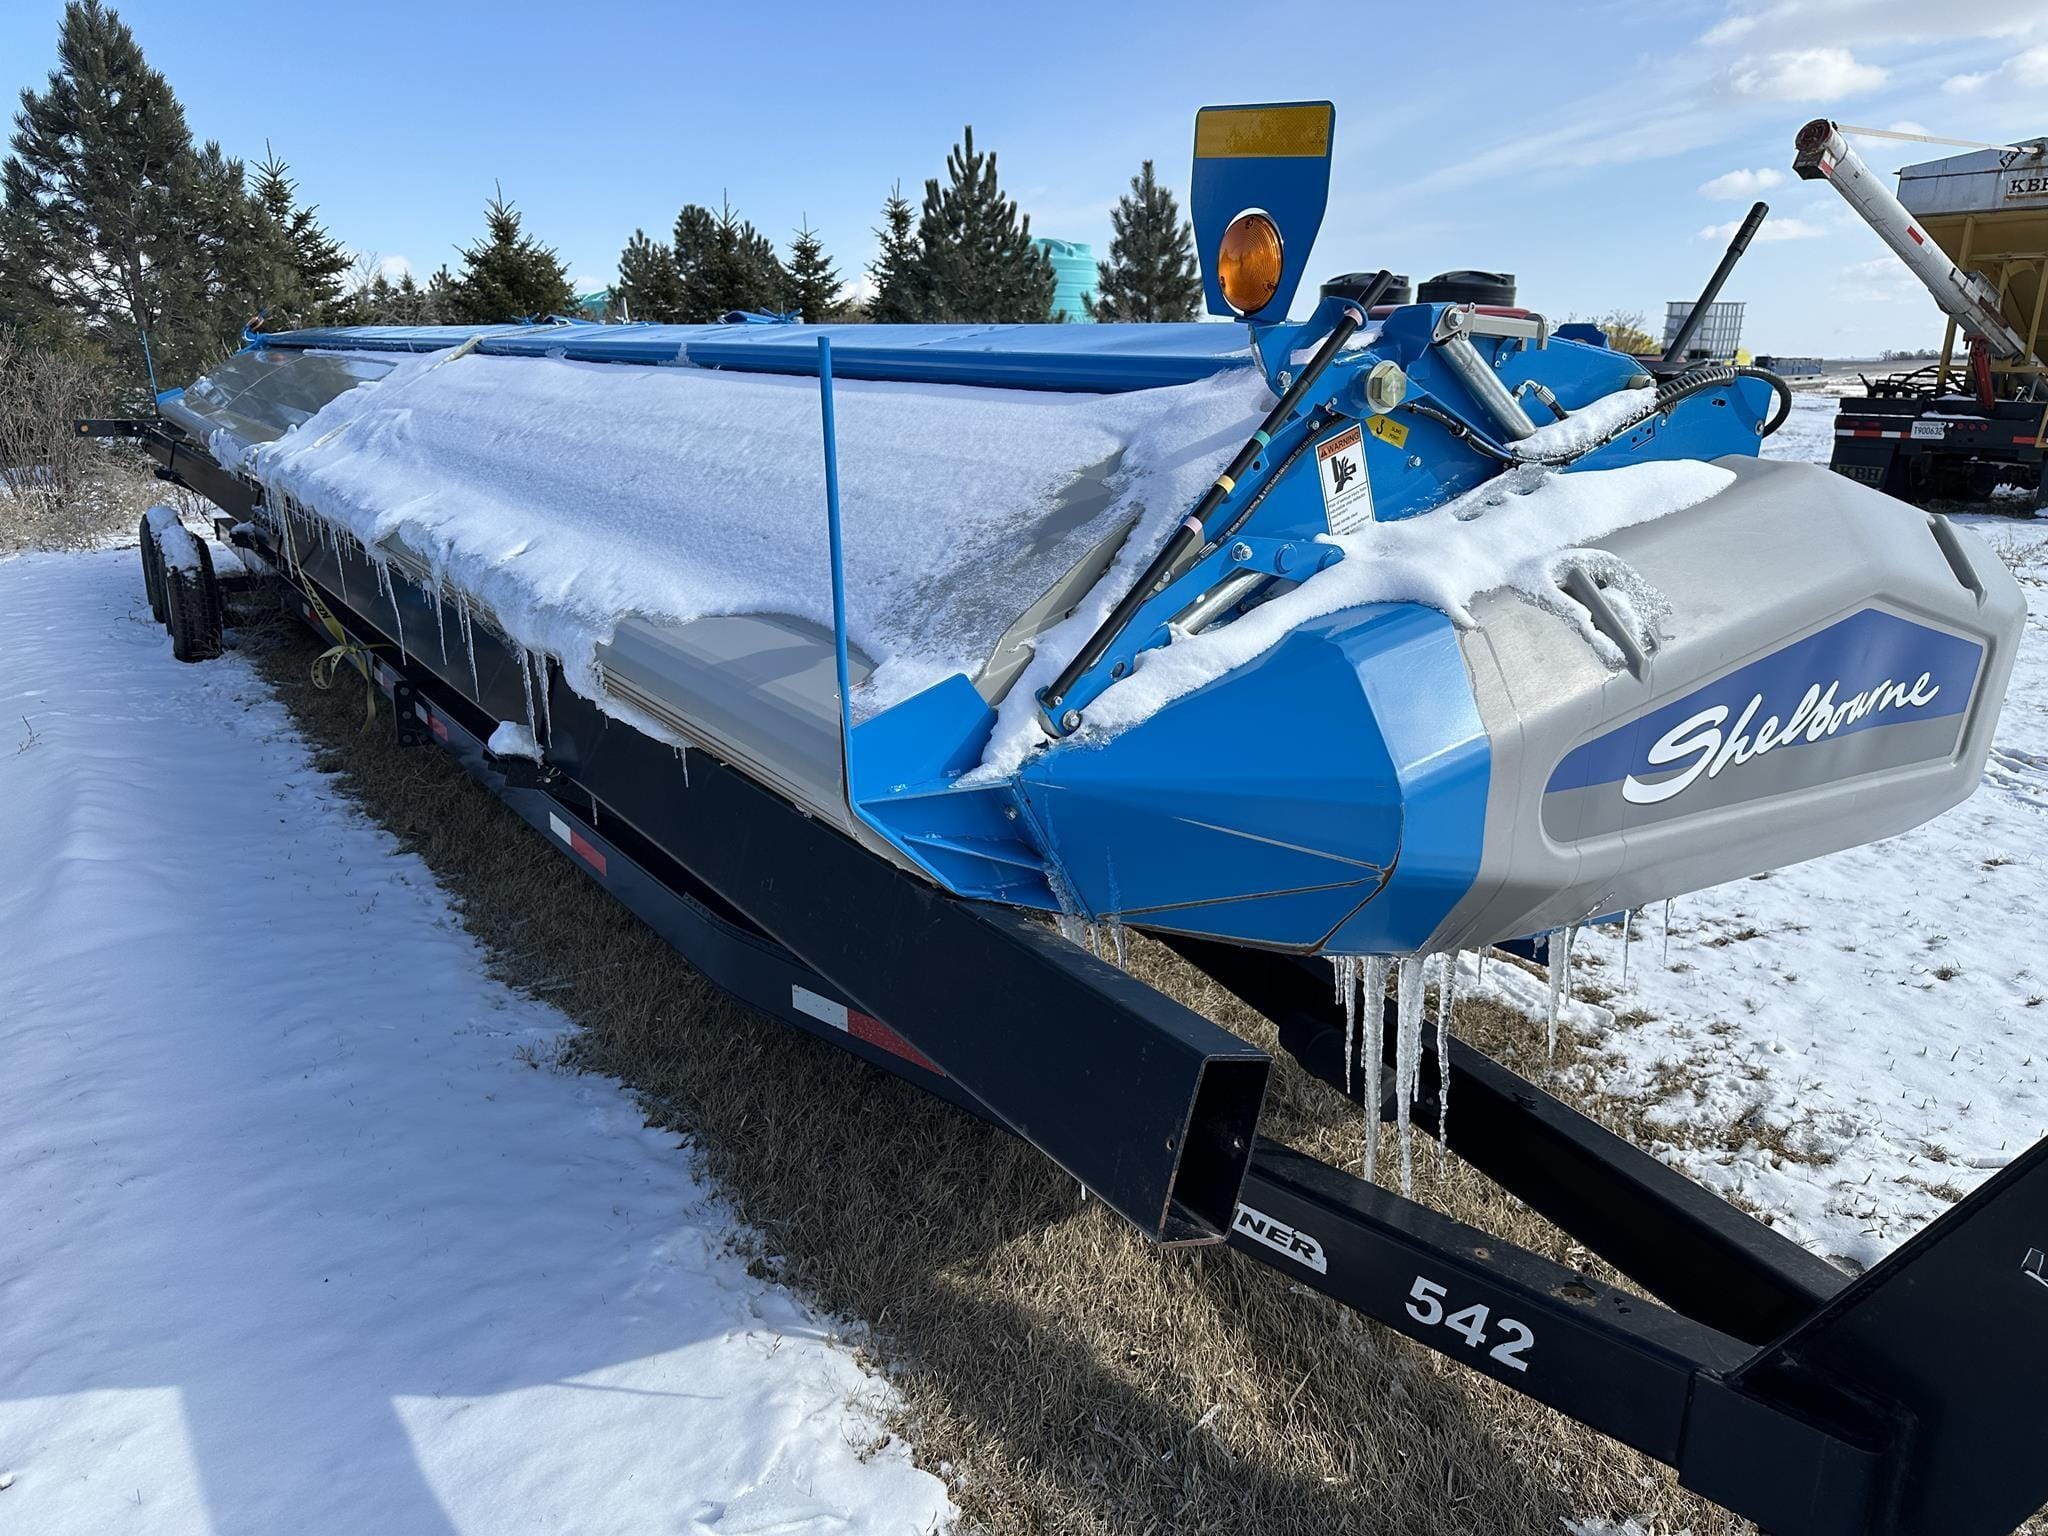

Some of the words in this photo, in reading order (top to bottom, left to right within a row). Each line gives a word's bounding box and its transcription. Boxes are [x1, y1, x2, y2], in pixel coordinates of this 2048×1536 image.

[1327, 431, 1360, 454] WARNING
[1622, 671, 1940, 804] Shelbourne
[1238, 1210, 1317, 1260] NER
[1405, 1276, 1535, 1372] 542
